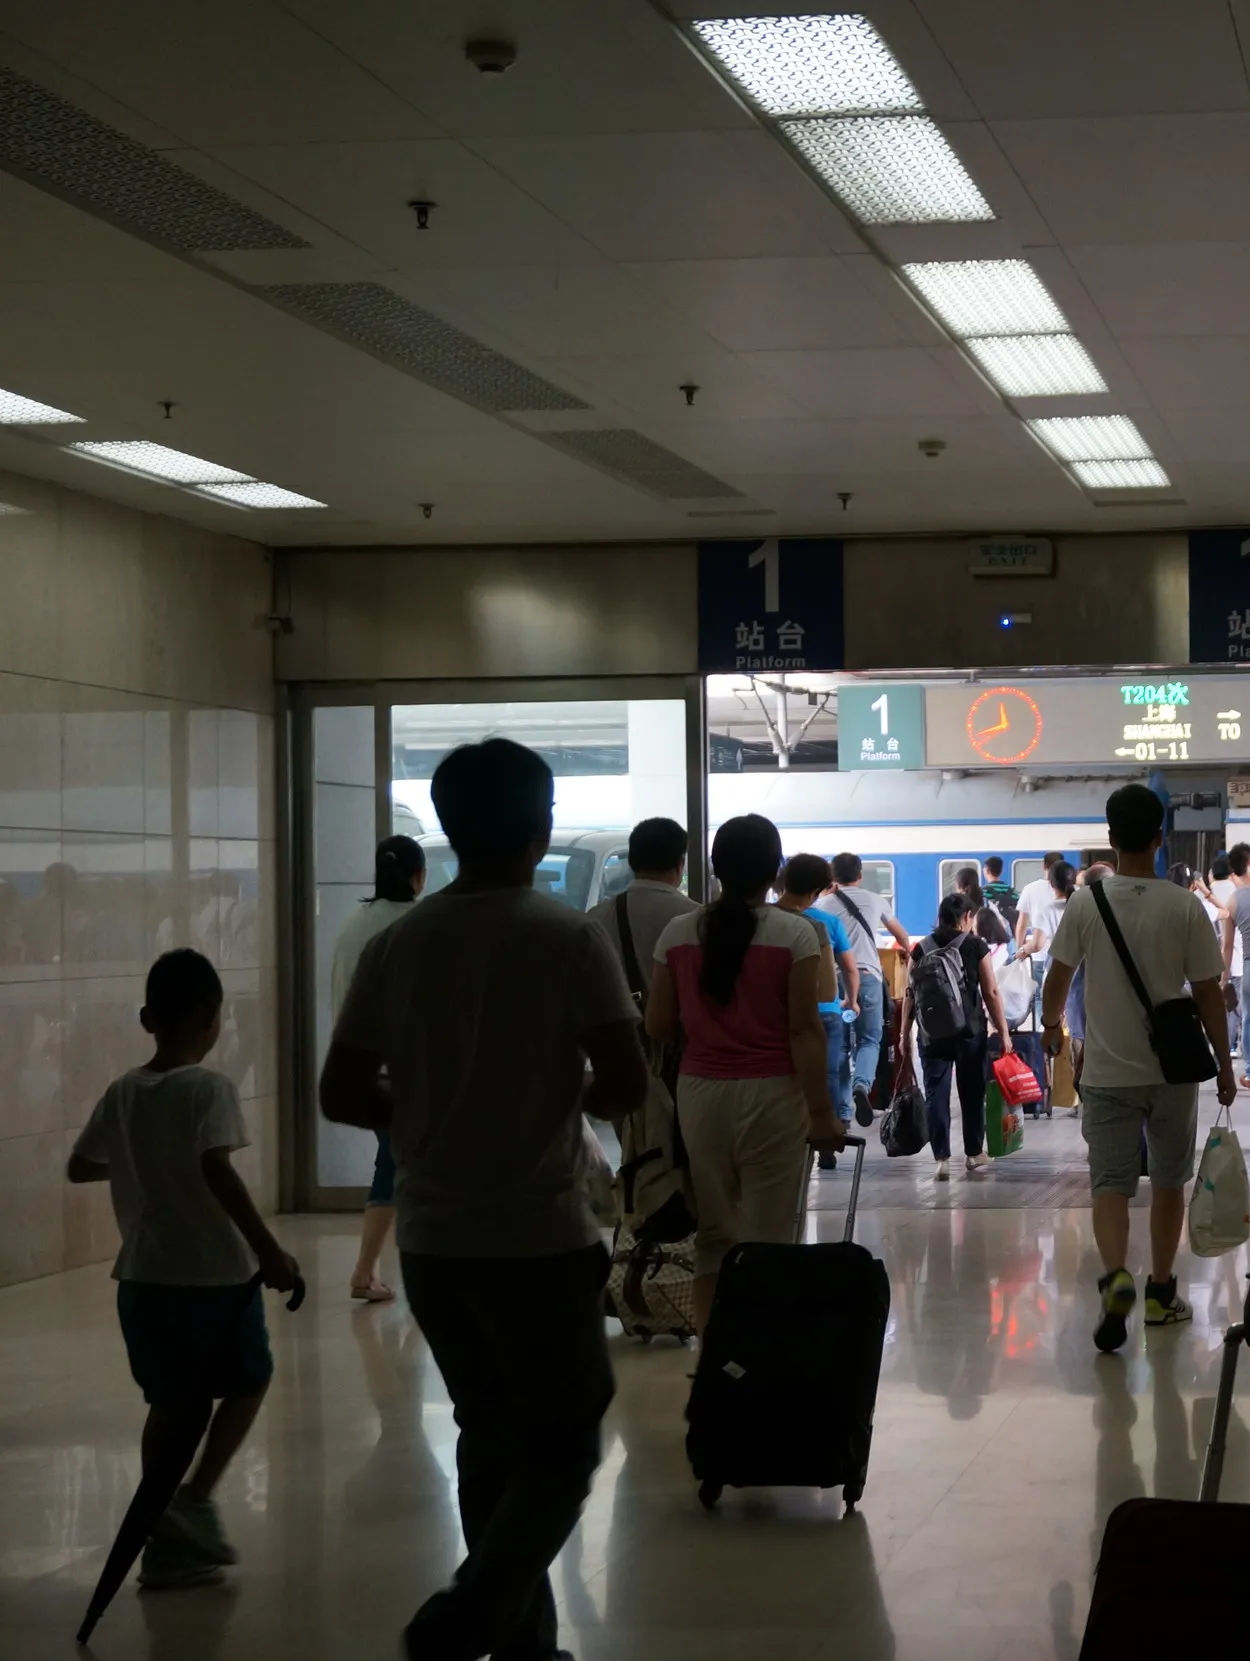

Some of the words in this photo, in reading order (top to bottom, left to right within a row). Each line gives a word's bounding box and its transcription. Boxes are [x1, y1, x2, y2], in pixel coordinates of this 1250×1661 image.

[748, 538, 780, 613] 1
[735, 620, 805, 651] 站台
[735, 655, 806, 669] Platform
[1121, 682, 1190, 705] T204次
[871, 693, 888, 735] 1
[1142, 704, 1176, 722] 上海
[1123, 723, 1192, 740] SHANGHAI
[1217, 723, 1241, 740] TO
[861, 737, 899, 751] 站台
[860, 751, 900, 761] Platform
